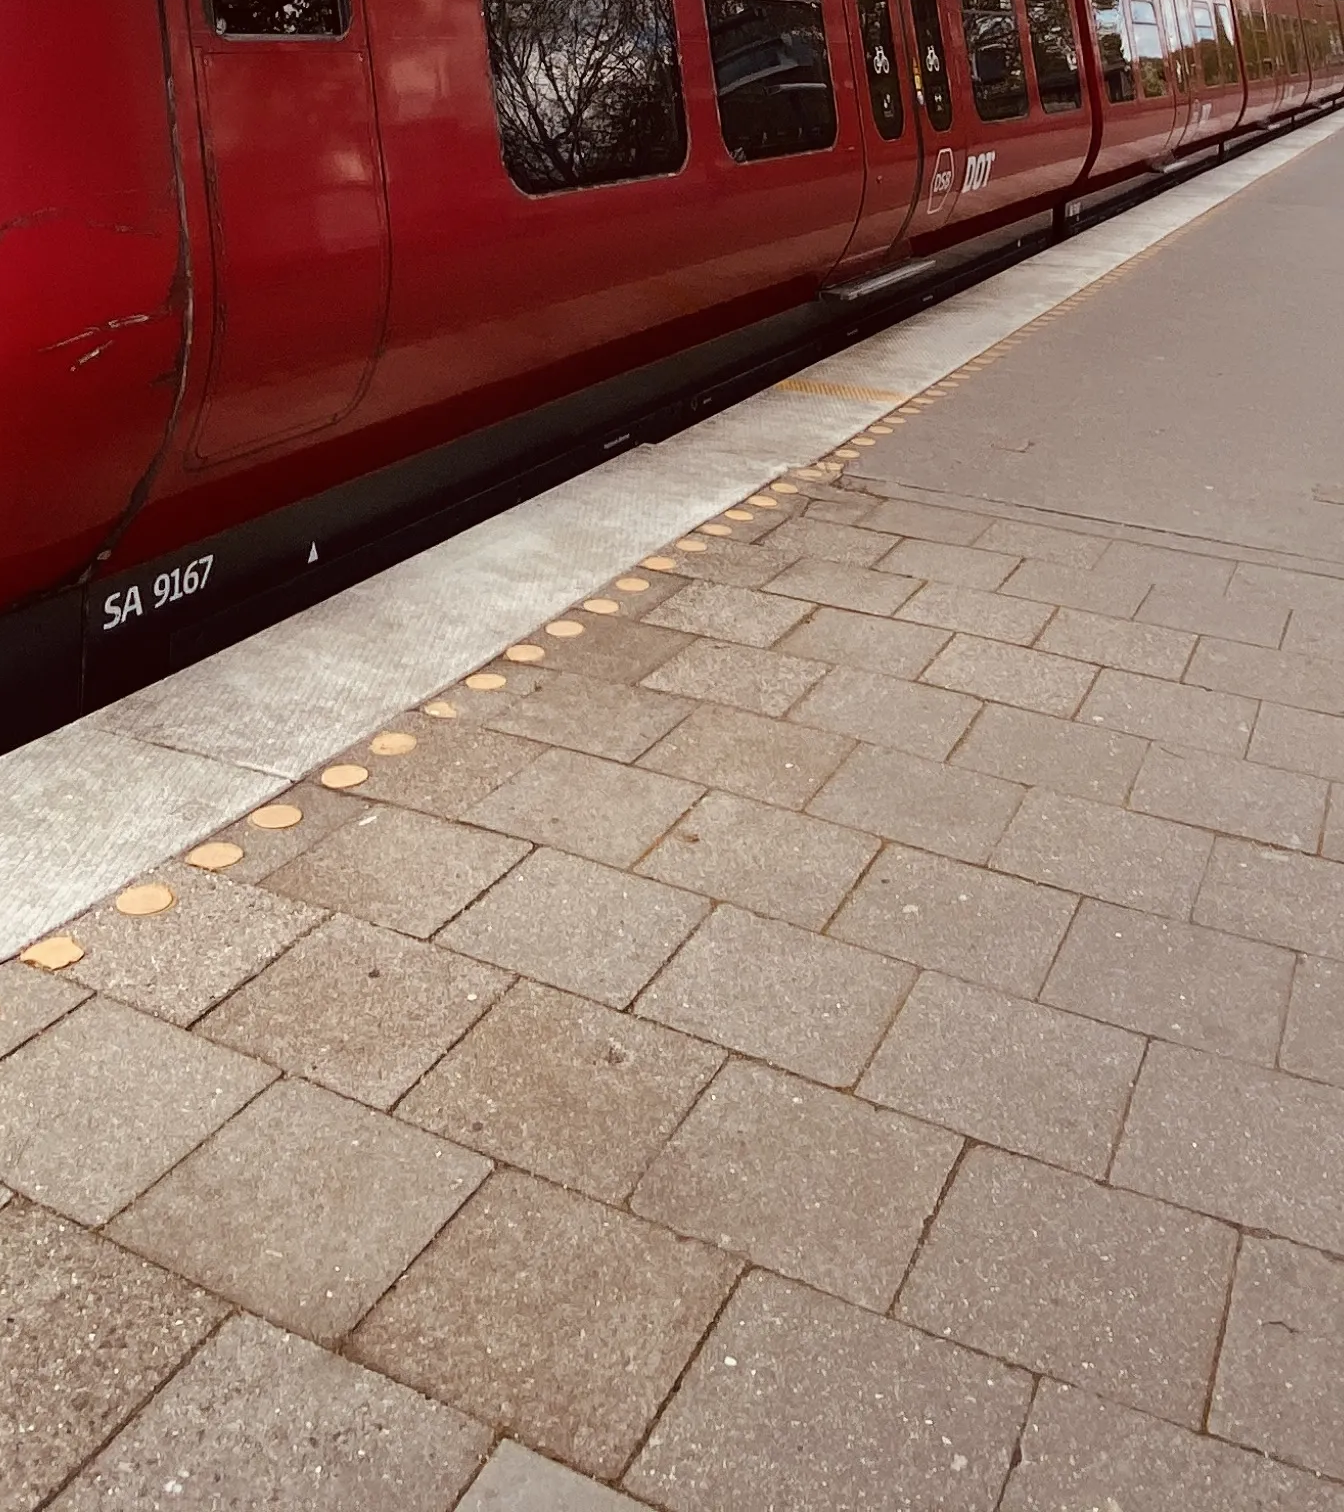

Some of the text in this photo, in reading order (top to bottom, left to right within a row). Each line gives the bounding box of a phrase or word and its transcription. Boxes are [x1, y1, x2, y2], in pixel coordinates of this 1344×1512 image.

[933, 170, 952, 193] DSB
[961, 150, 996, 194] DOT
[103, 554, 214, 630] SA 9167
